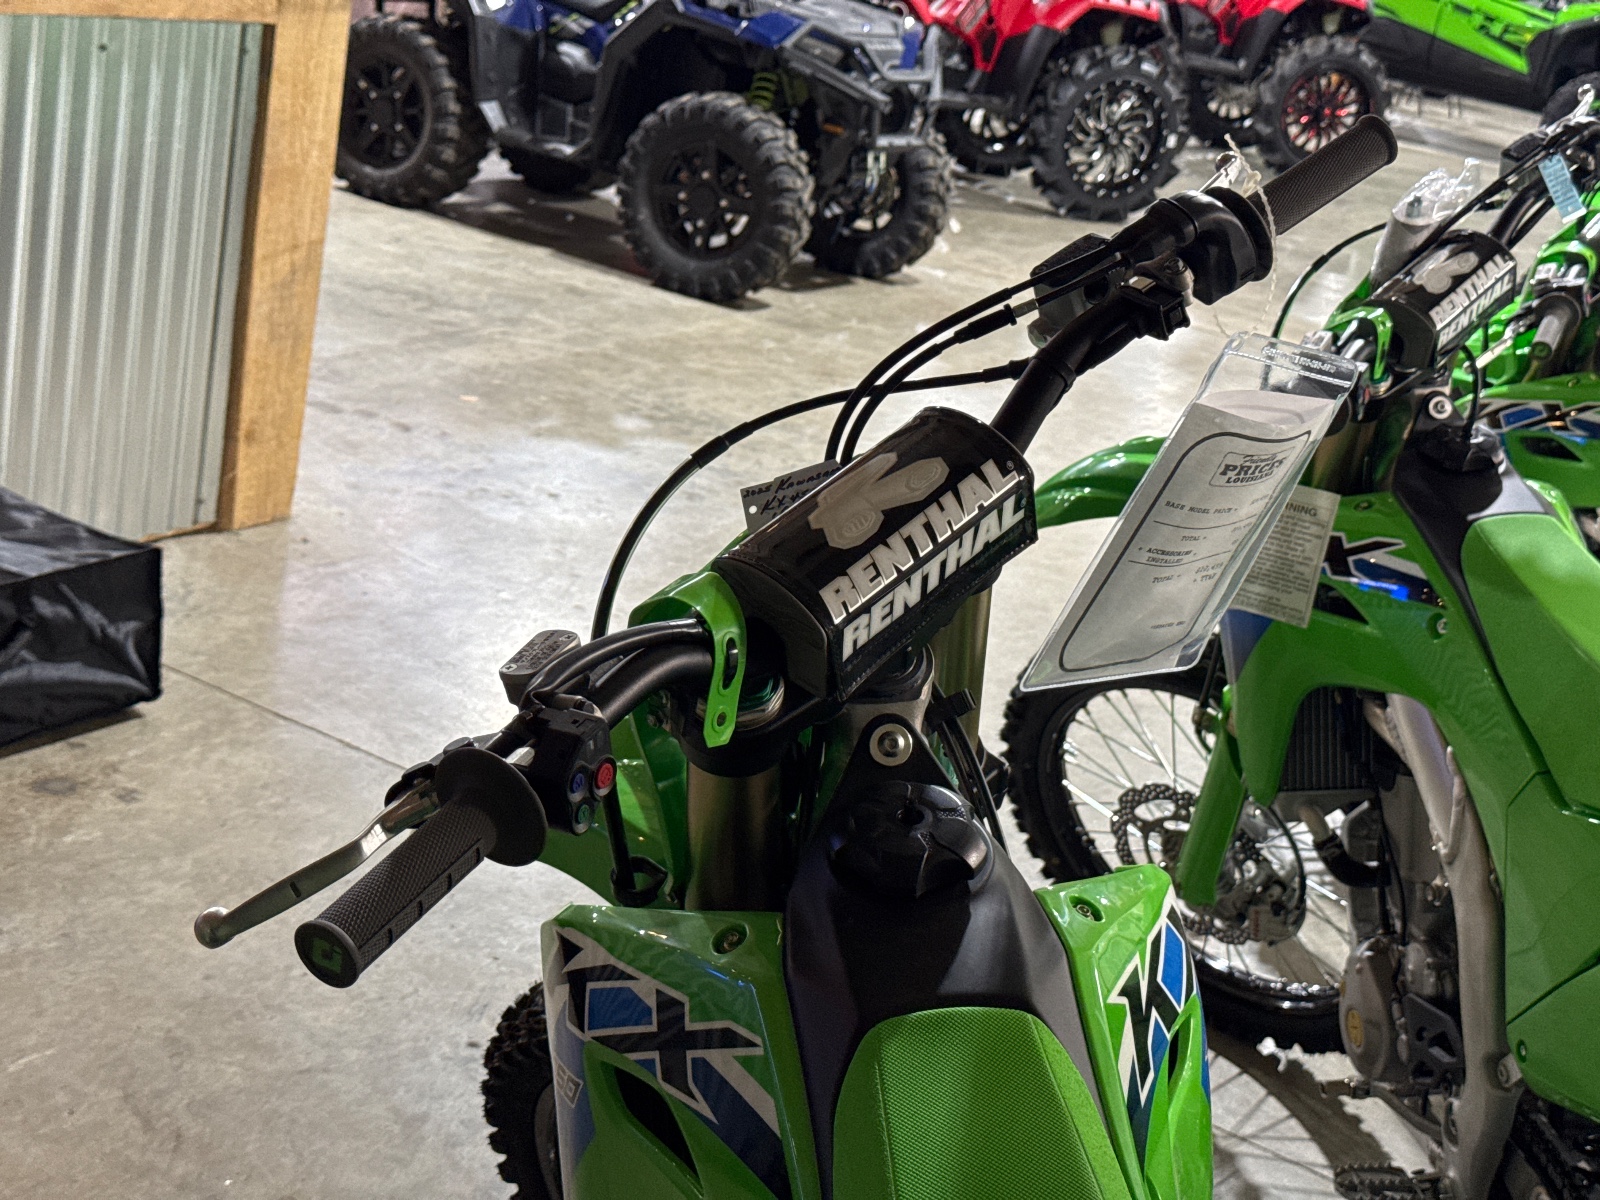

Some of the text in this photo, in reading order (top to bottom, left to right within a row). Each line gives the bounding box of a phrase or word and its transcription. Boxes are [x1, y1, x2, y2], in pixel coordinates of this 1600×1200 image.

[1429, 254, 1515, 331] RENTHAL
[819, 458, 1020, 625] RENTHAL
[1165, 500, 1186, 512] BASE
[843, 493, 1025, 662] RENTHAL
